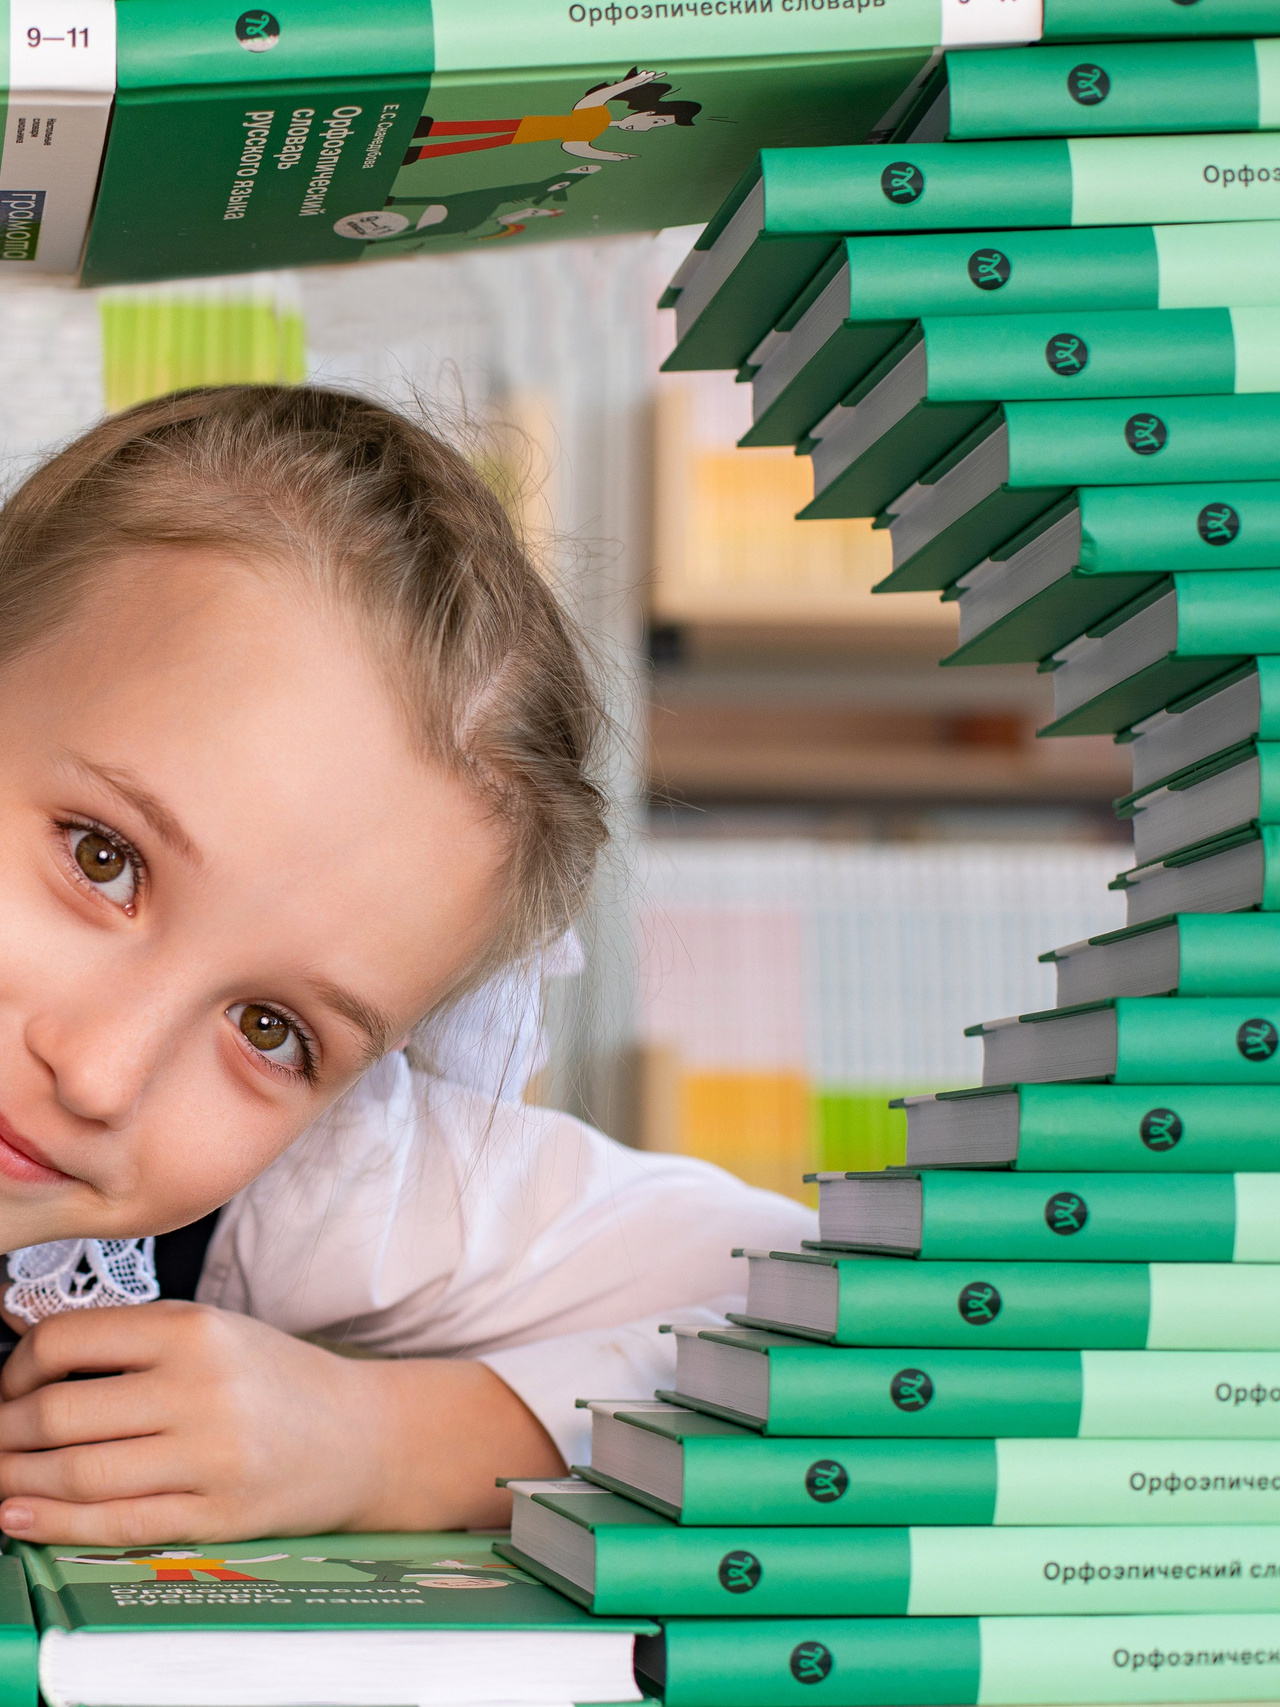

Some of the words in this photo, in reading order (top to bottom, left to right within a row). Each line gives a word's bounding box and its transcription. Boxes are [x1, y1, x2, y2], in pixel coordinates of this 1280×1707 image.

[568, 0, 774, 28] Орфоэпический
[236, 110, 275, 177] русского
[272, 107, 315, 170] словарь
[298, 105, 363, 217] Орфоэпический
[362, 121, 393, 169] Скачедубова
[223, 179, 255, 221] языка
[1, 193, 36, 259] грамота
[110, 1587, 422, 1595] Орфоэпический
[1043, 1560, 1242, 1585] Орфоэпический
[1249, 1563, 1280, 1579] сл
